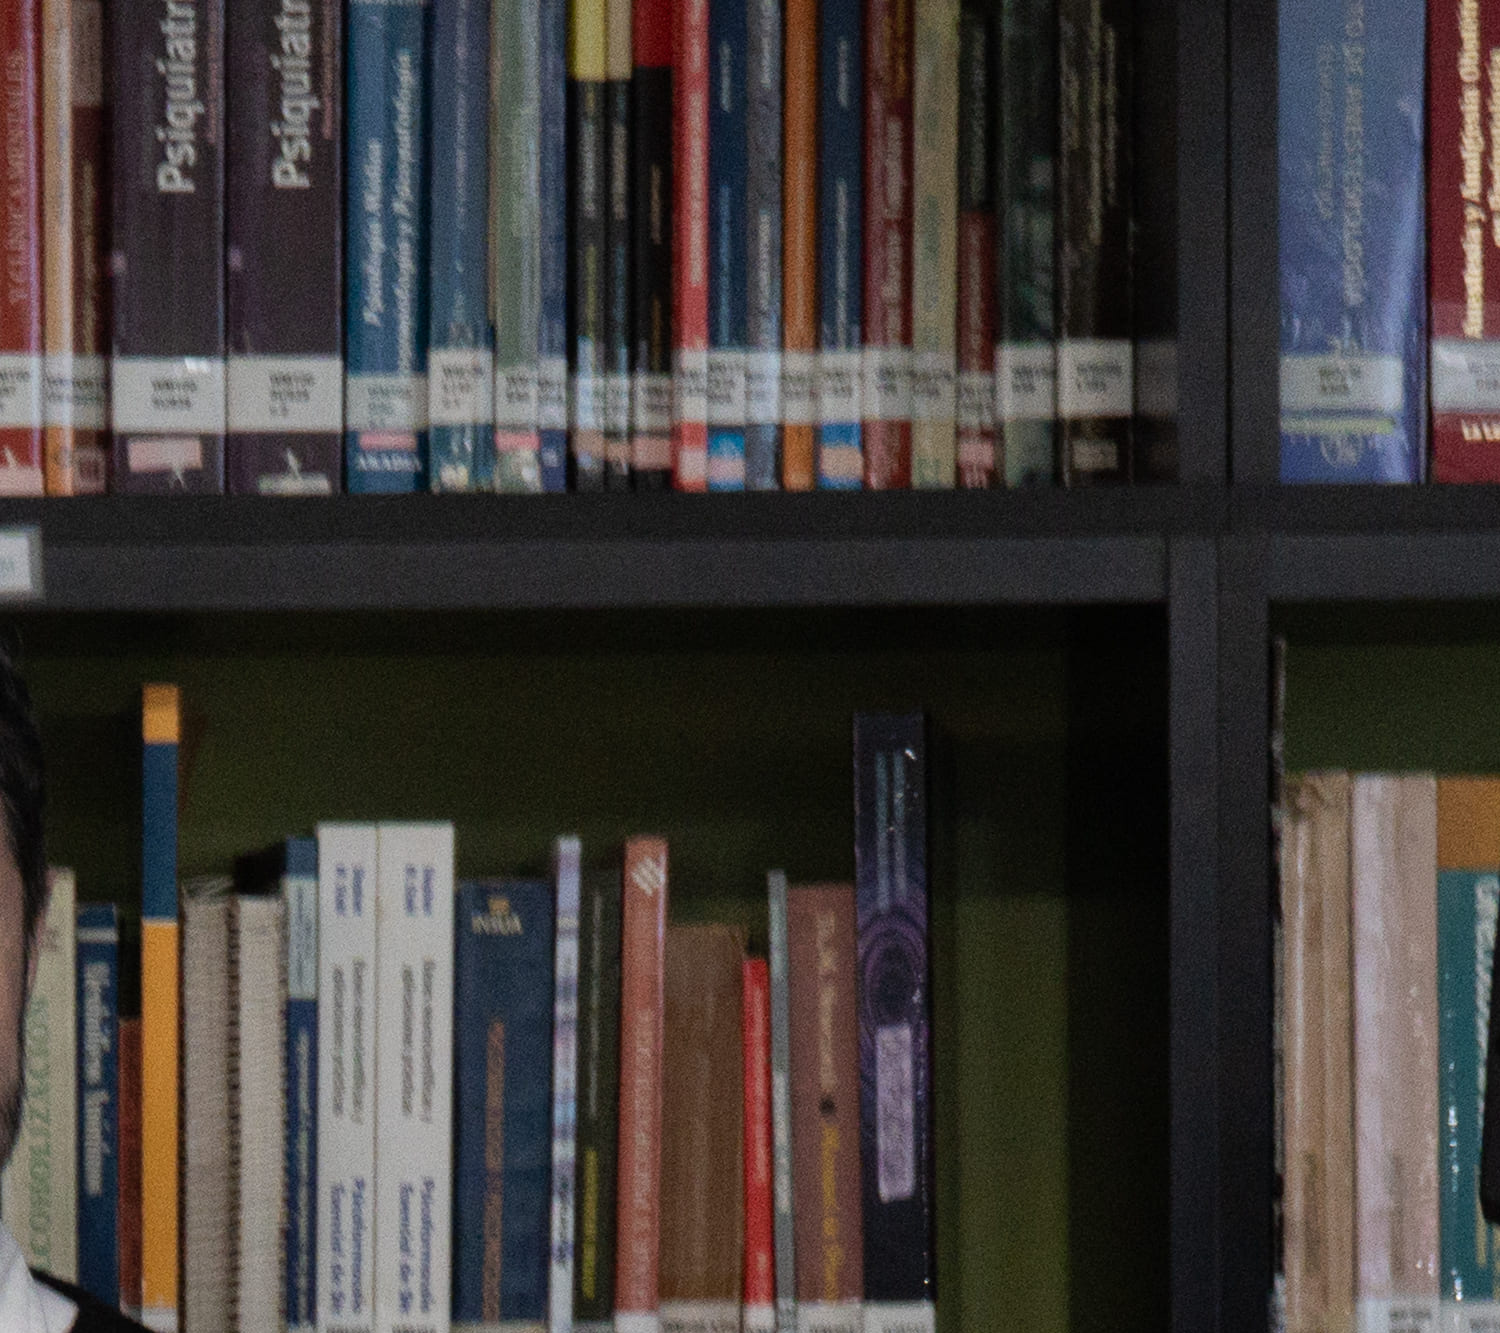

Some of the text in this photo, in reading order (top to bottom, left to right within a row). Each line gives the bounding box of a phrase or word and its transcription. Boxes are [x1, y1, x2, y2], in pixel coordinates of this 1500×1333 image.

[1459, 89, 1484, 201] Analgesia
[363, 220, 387, 326] Psicología
[1460, 225, 1484, 339] Anestesia
